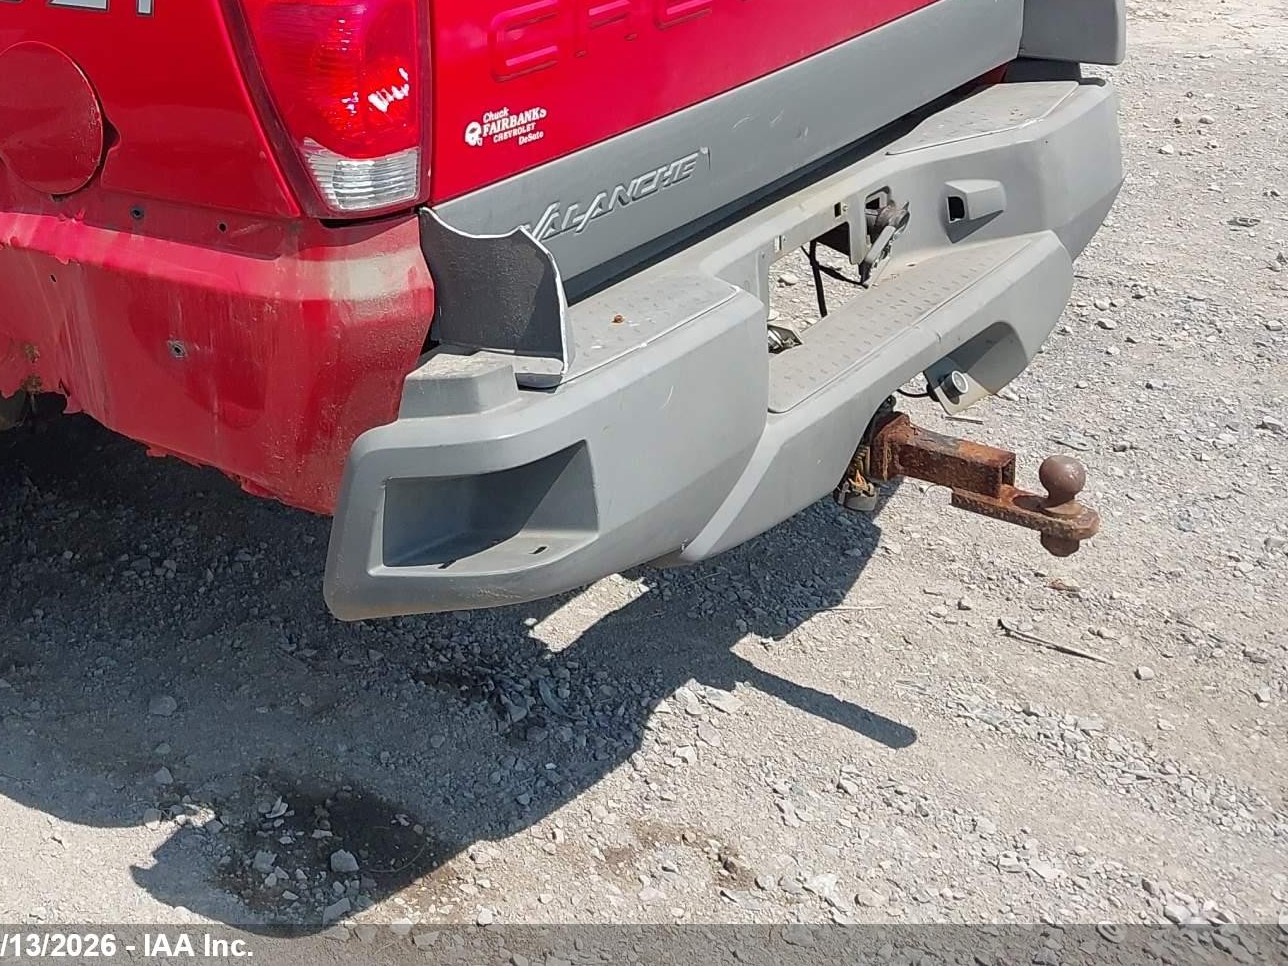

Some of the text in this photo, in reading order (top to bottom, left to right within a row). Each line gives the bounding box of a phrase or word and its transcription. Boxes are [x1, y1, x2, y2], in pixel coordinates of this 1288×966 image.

[482, 106, 548, 137] FAIRBANKS
[483, 106, 510, 123] Chuck
[493, 122, 537, 143] CHEVROLET
[520, 151, 700, 243] VALANCHE
